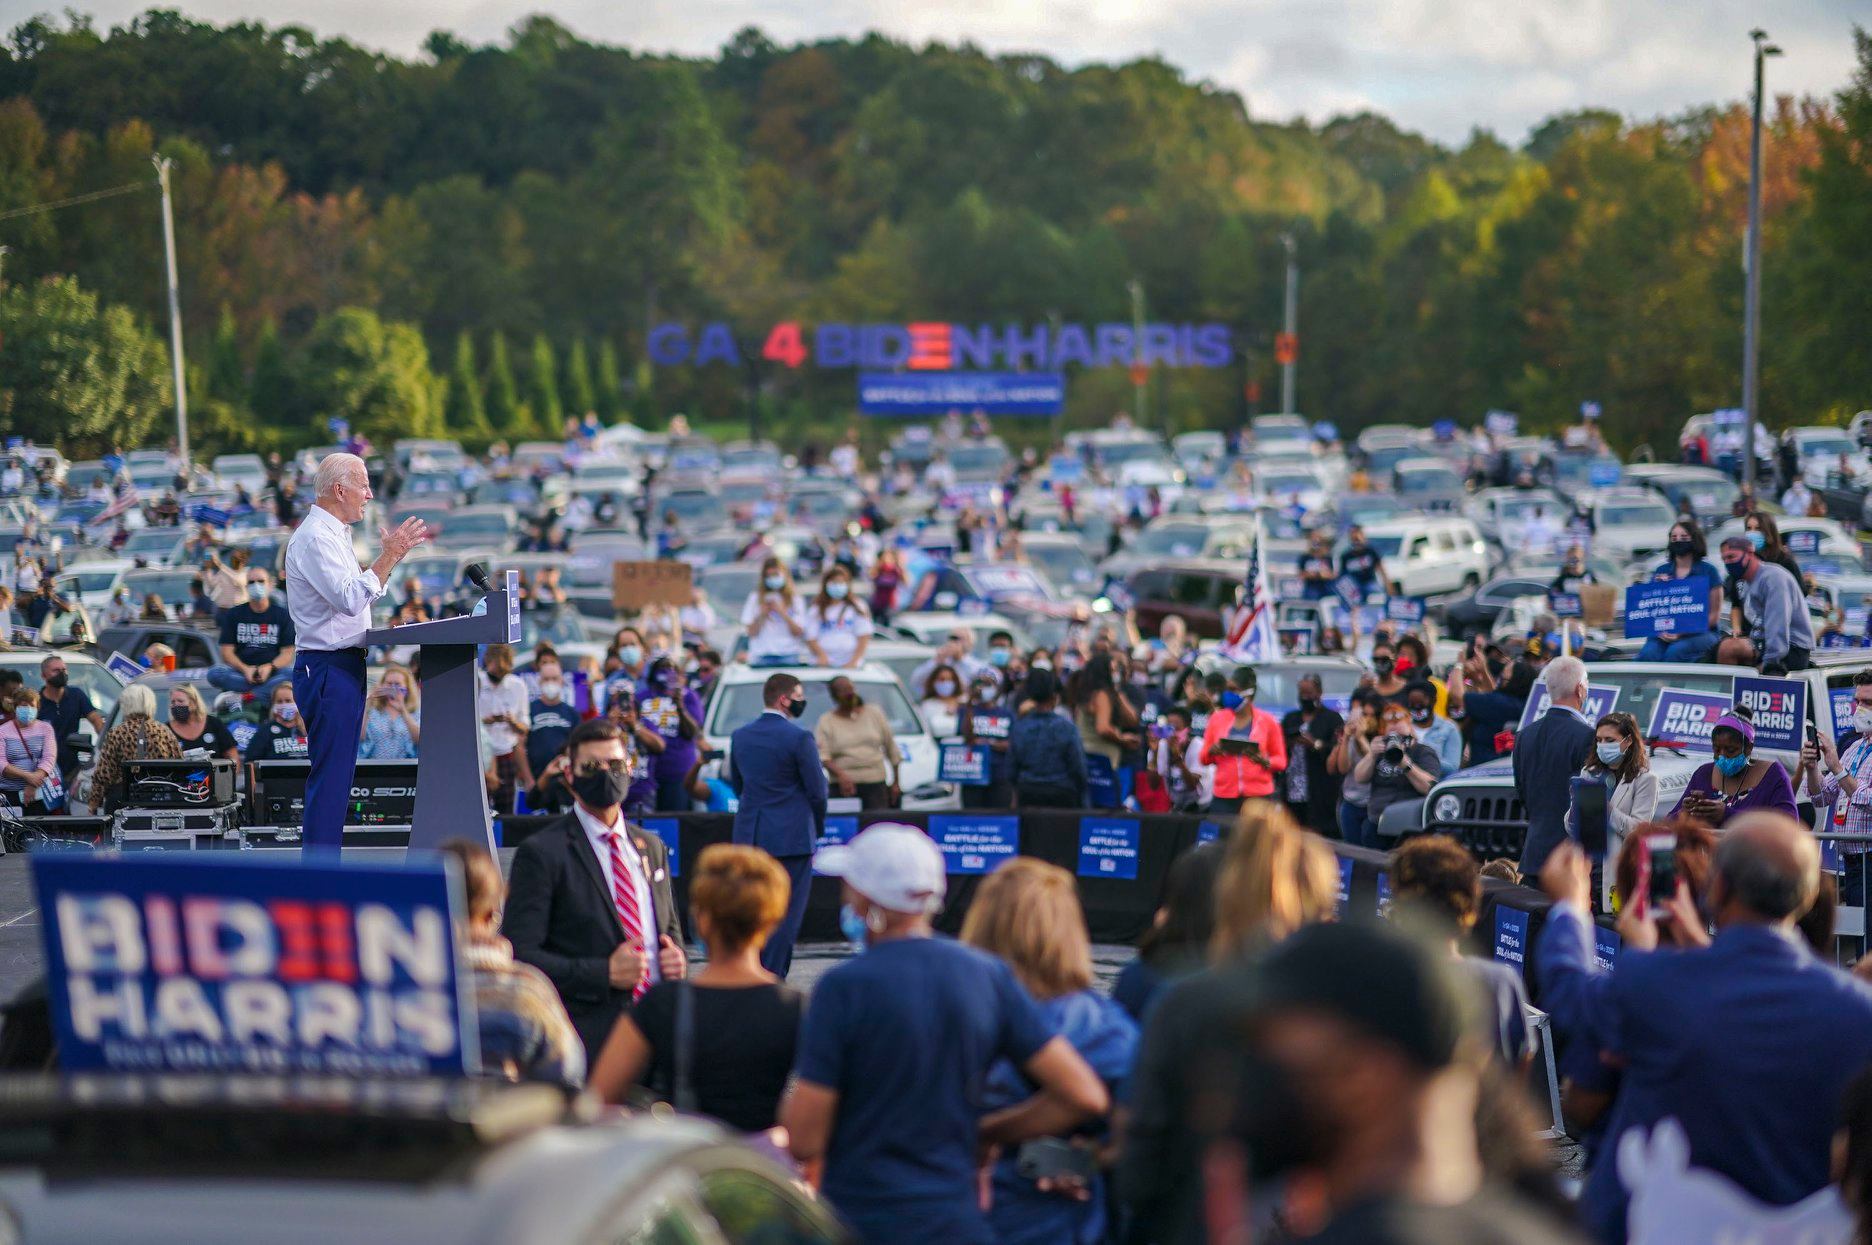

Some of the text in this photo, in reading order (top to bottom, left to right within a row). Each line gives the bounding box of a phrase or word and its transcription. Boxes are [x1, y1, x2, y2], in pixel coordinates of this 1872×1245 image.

[649, 323, 740, 367] GA
[763, 321, 807, 368] 4
[237, 623, 279, 636] BIDEN
[1741, 690, 1795, 713] BIDEN
[1661, 719, 1716, 737] HARR
[1751, 710, 1795, 730] ARRIS
[55, 893, 450, 985] BIDEN
[67, 973, 455, 1056] HARRIS
